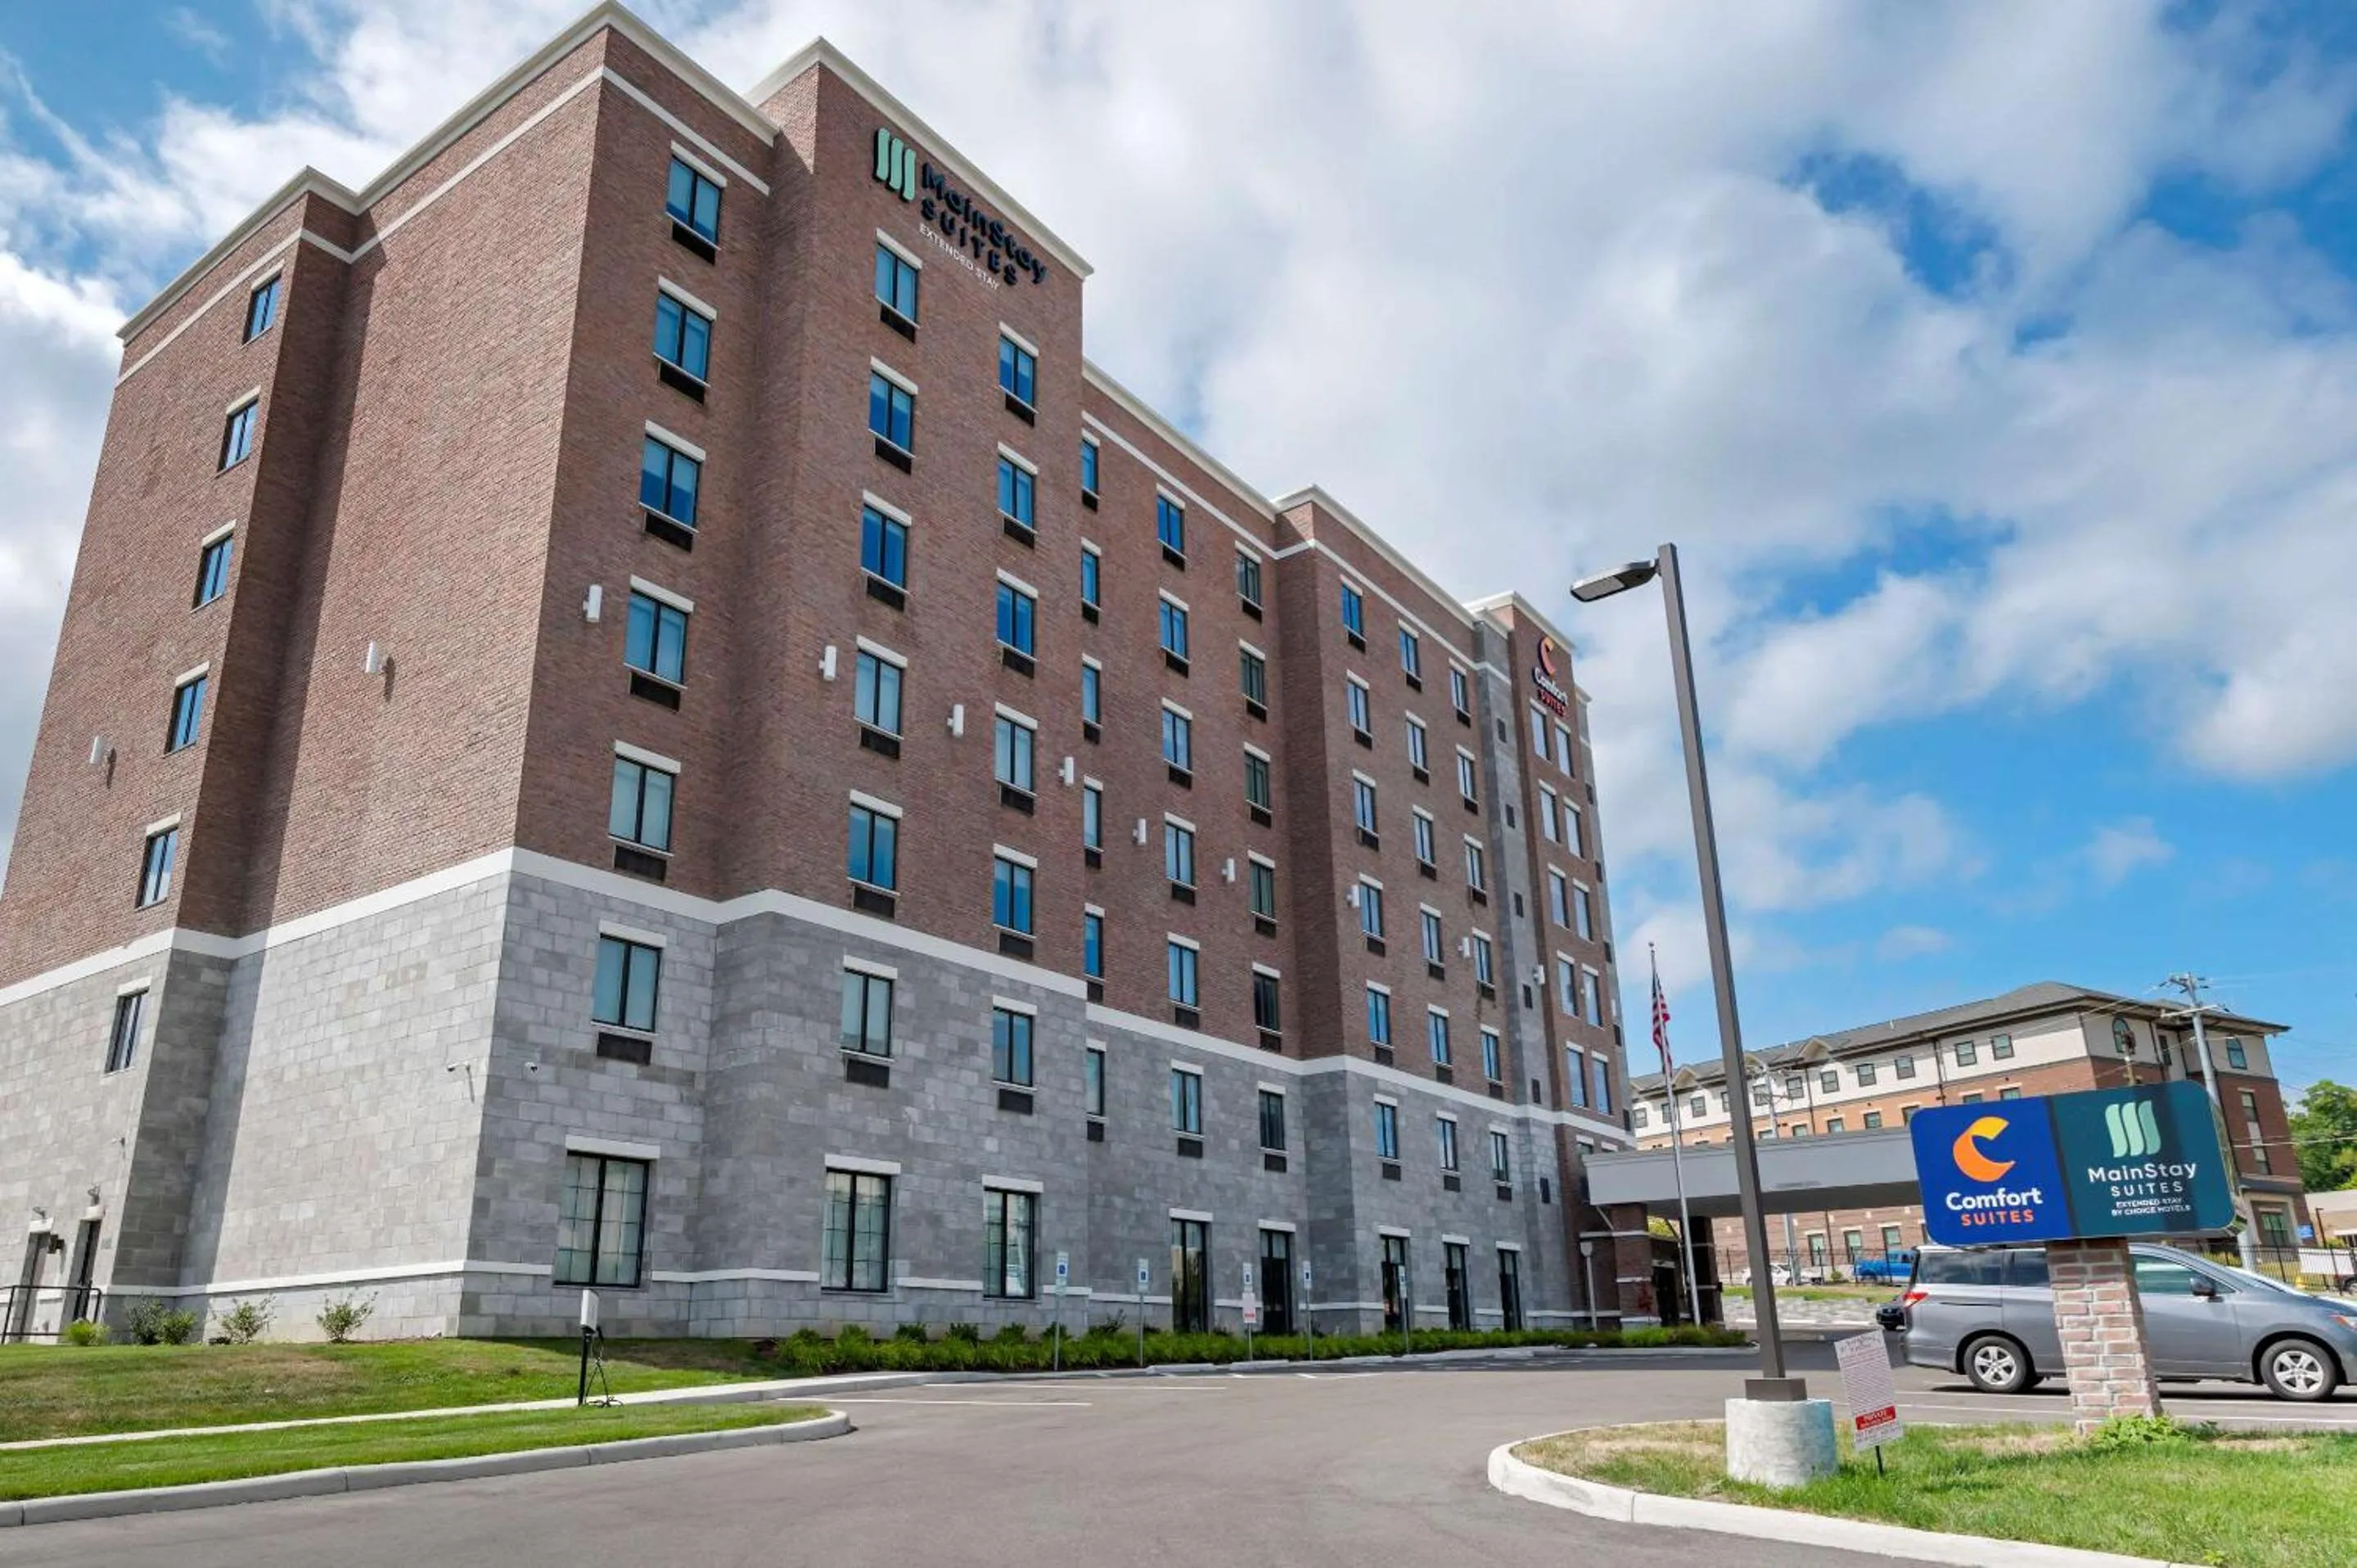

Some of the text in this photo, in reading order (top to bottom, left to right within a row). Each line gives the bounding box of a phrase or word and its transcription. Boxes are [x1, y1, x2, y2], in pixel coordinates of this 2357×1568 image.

[922, 162, 1047, 284] MainStay
[921, 196, 1017, 286] SUITES
[919, 223, 1000, 290] EXTENDED STAY
[2088, 1163, 2197, 1183] MainStay
[1945, 1187, 2044, 1210] Comfort
[2111, 1181, 2183, 1196] SUITES
[2116, 1199, 2161, 1209] EXTENDED
[2124, 1206, 2156, 1215] CHOICE
[1960, 1209, 2035, 1226] SUITES
